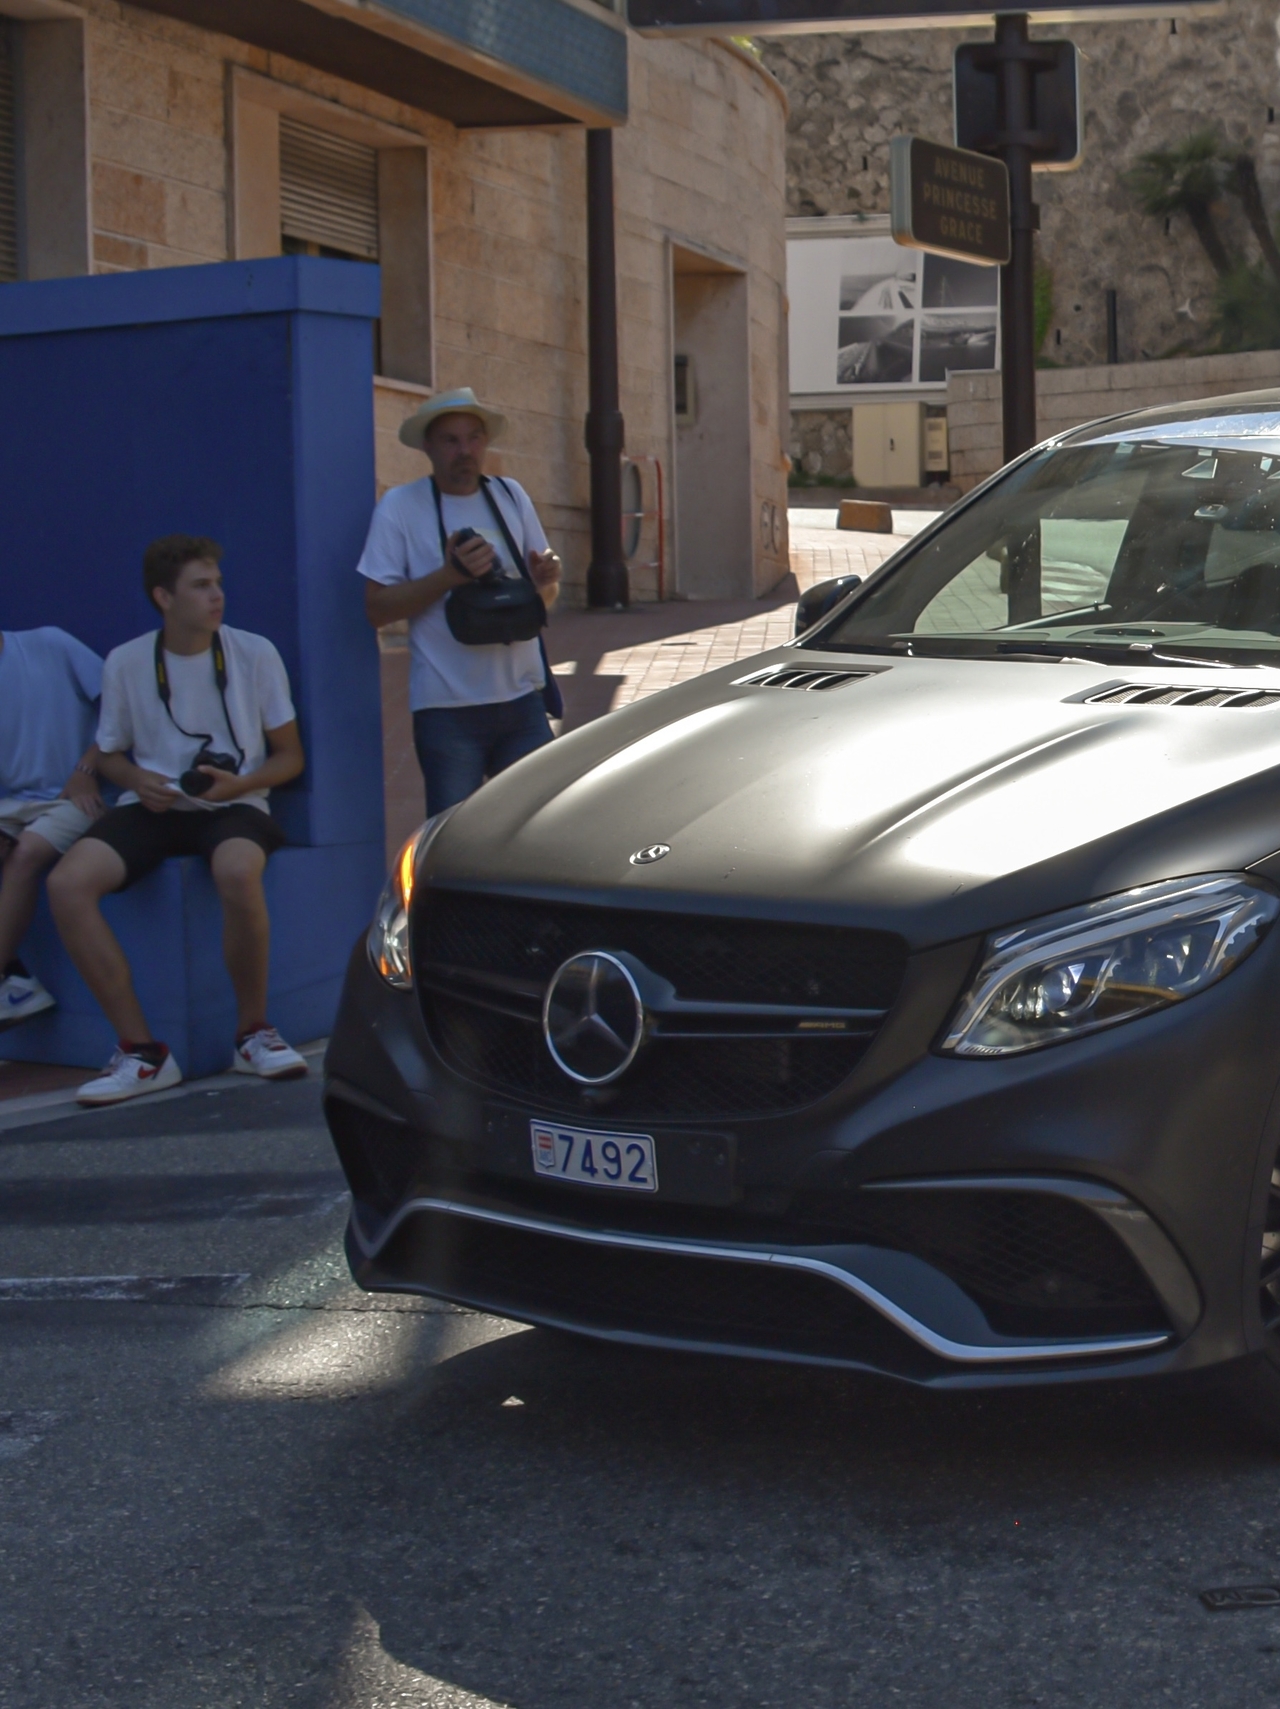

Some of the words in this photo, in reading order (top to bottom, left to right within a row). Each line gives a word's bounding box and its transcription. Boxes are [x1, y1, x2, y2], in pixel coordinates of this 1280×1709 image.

[935, 157, 984, 188] AVENUE
[924, 182, 996, 220] PRINCESSE
[940, 216, 983, 244] GRACE
[558, 1134, 648, 1183] 7492
